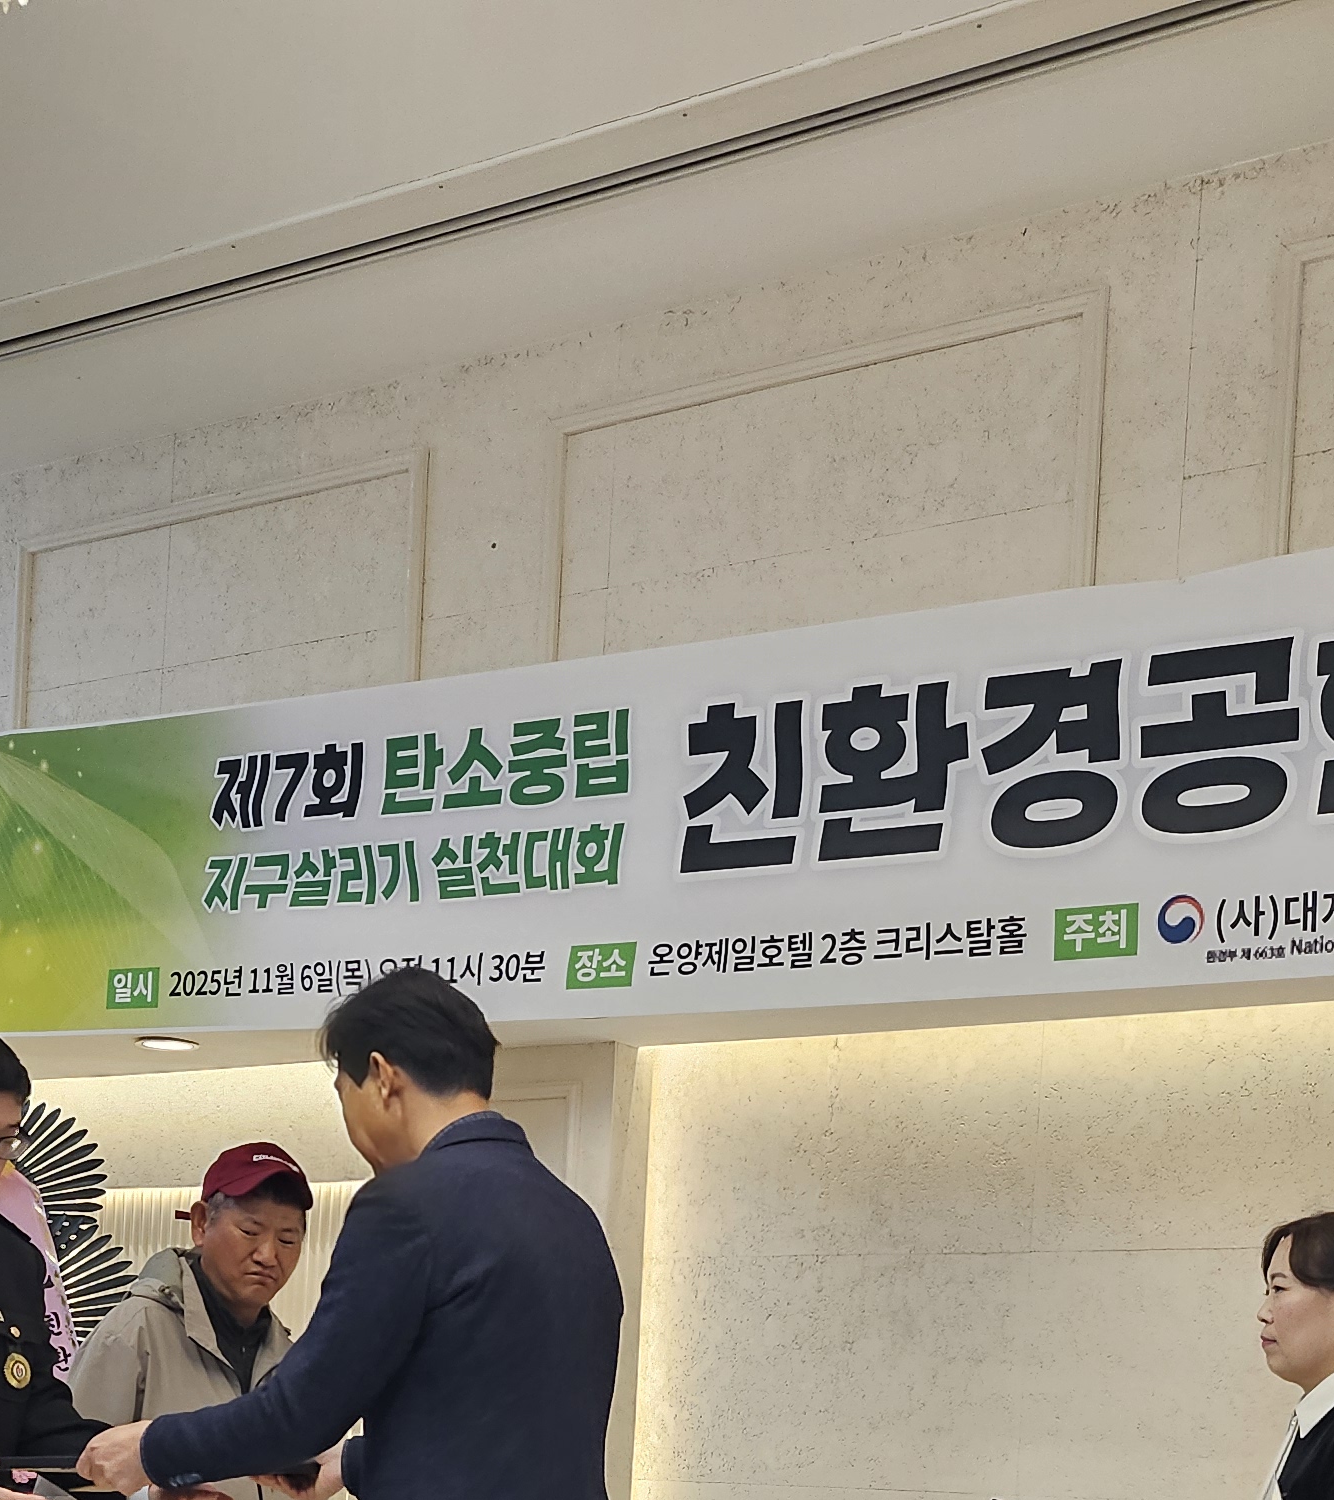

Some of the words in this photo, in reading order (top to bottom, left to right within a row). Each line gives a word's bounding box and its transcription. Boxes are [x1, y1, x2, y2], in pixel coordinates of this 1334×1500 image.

[212, 741, 364, 829] 제7회
[380, 708, 630, 816] 탄소중립
[203, 840, 420, 911] 지구살리기
[431, 822, 626, 900] 실천대회
[574, 948, 627, 982] 장소
[647, 931, 813, 977] 온양제일호텔
[819, 927, 867, 966] 2층
[873, 915, 1028, 961] 크리스탈홀
[1063, 908, 1127, 952] 주최
[112, 972, 153, 1003] 일시
[168, 965, 243, 998] 2025년
[248, 962, 295, 996] 11월
[432, 952, 484, 986] 11시
[488, 950, 546, 984] 30분
